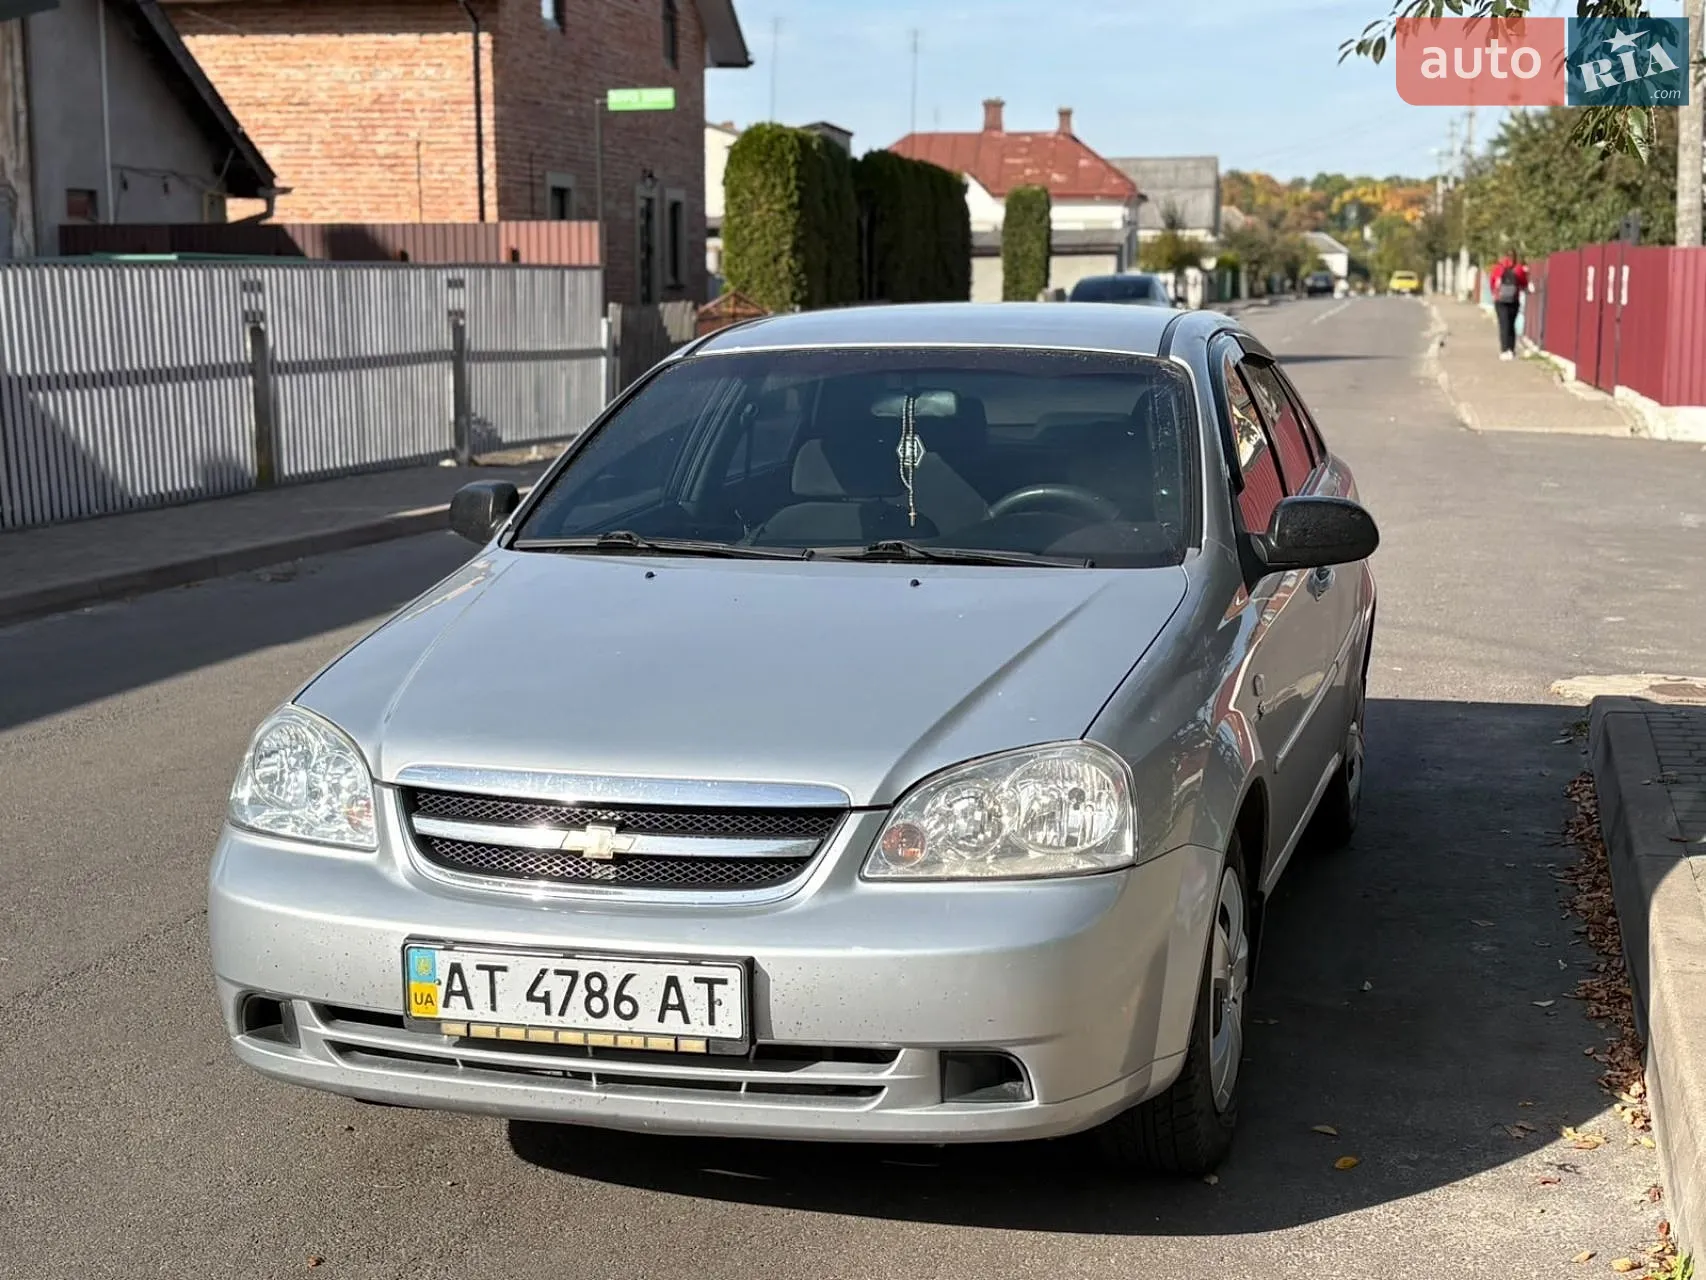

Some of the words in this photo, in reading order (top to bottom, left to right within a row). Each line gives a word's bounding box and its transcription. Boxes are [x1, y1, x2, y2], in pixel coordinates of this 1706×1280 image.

[414, 992, 435, 1007] UA
[442, 962, 508, 1011] AT
[526, 968, 640, 1021] 4786
[657, 975, 728, 1026] AT
